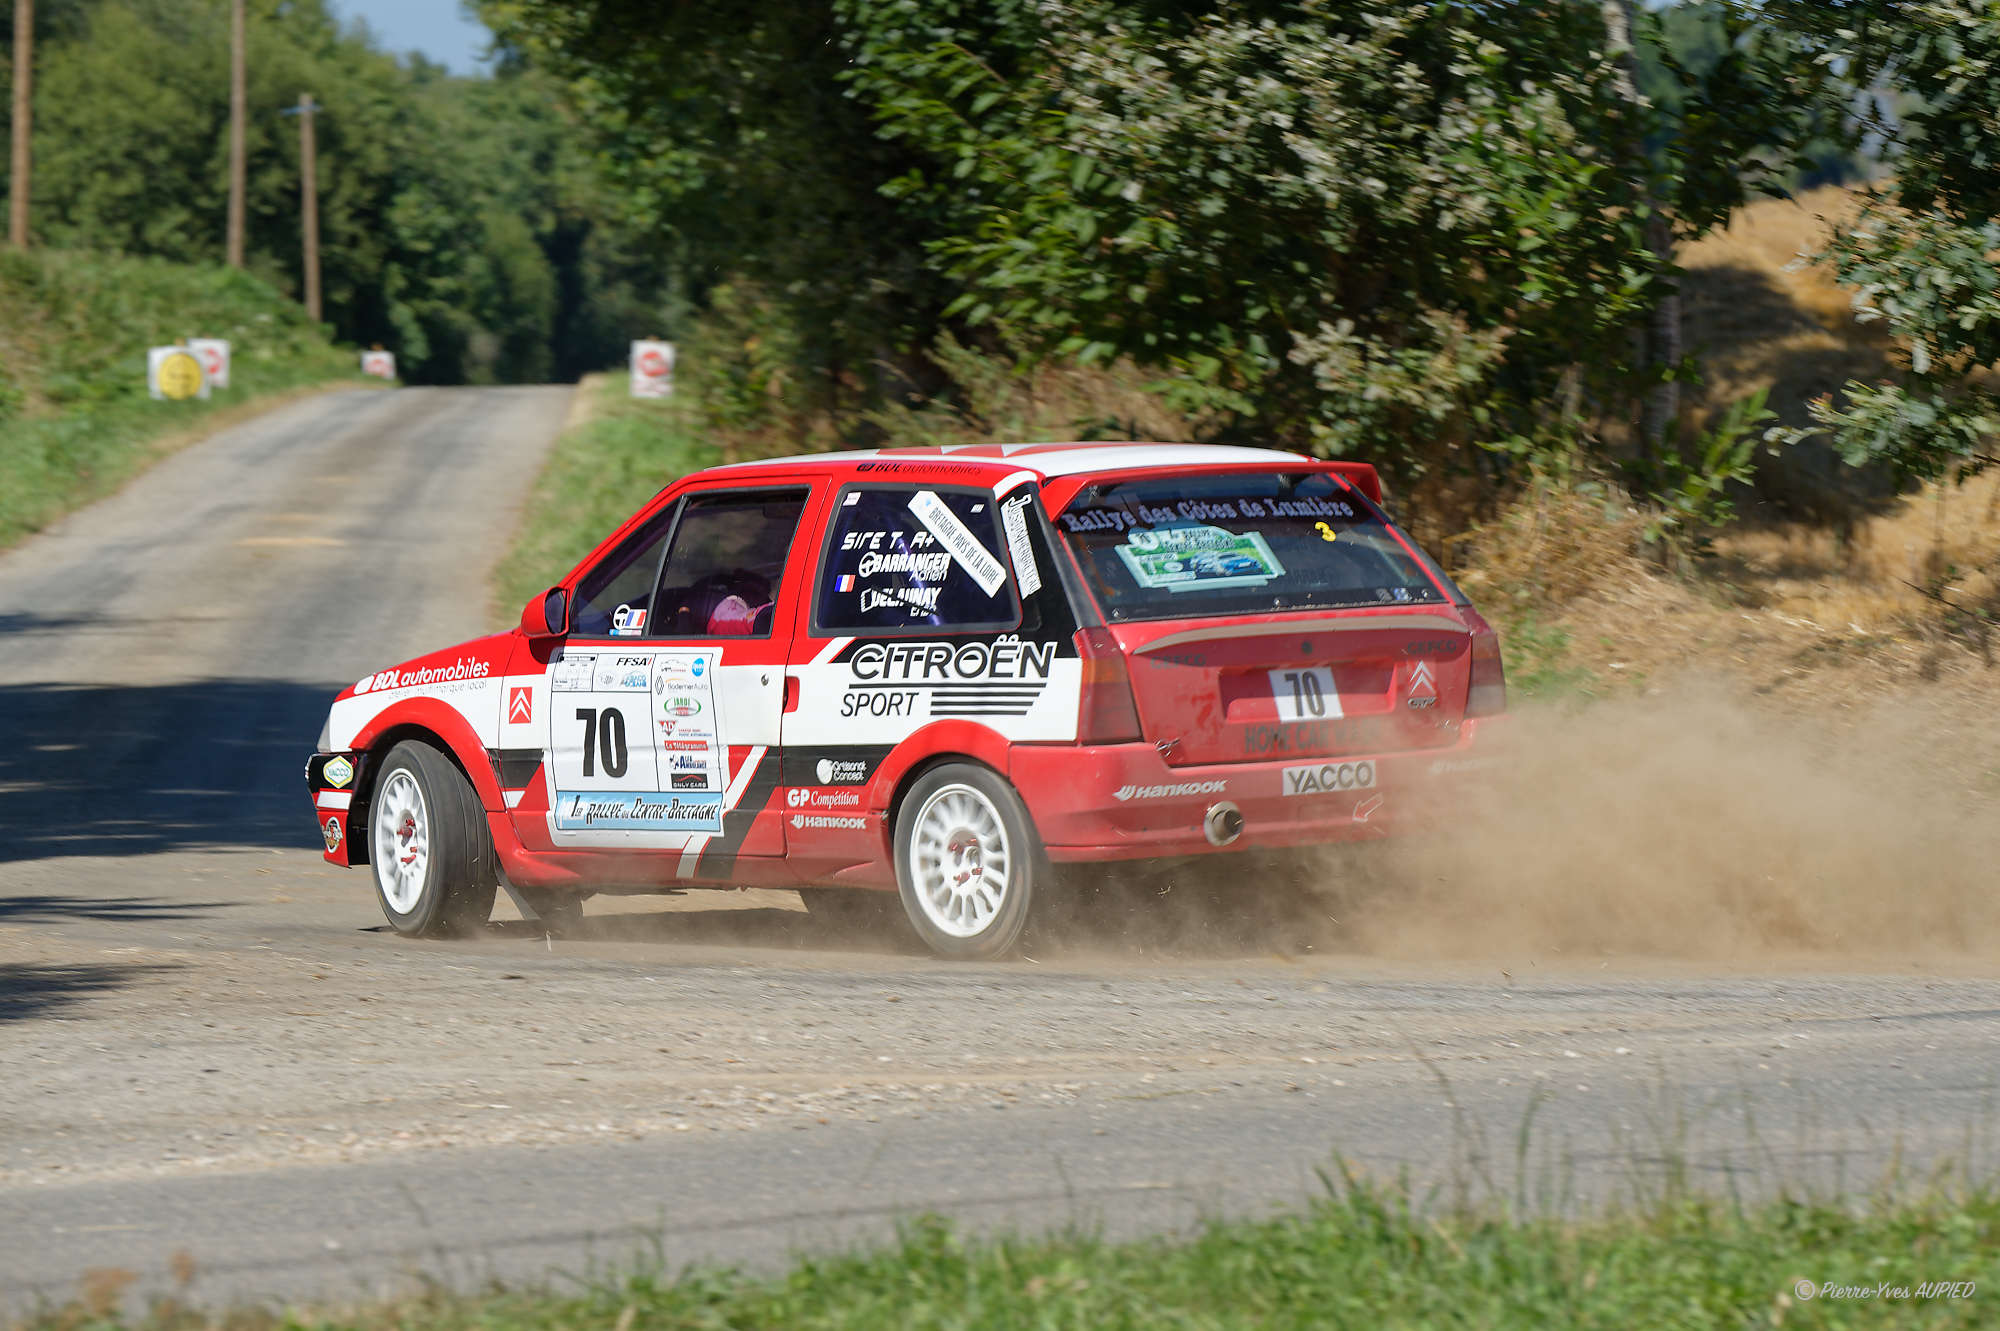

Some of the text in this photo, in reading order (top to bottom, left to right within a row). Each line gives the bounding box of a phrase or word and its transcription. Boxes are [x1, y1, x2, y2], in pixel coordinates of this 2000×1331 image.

[1061, 496, 1354, 532] Rallye des Côtes de Lumière
[1315, 521, 1336, 542] 3
[929, 507, 999, 585] BRETAGNE PAYS DE LA LOIRE
[873, 552, 952, 573] BARRANGER
[909, 569, 948, 582] Adrien
[616, 657, 647, 666] FFSA
[852, 635, 1054, 680] CITROËN
[371, 656, 490, 691] BDL automobiles
[841, 692, 919, 717] SPORT
[1284, 671, 1326, 717] 70
[576, 707, 628, 778] 70
[328, 768, 349, 777] YACCO
[1288, 762, 1373, 793] YACCO
[788, 789, 859, 810] GP Compétition
[1134, 780, 1230, 799] Hankook
[587, 803, 624, 824] RALLYE
[630, 798, 717, 820] CENTRE-BRETAGNE
[805, 816, 866, 829] Hankook
